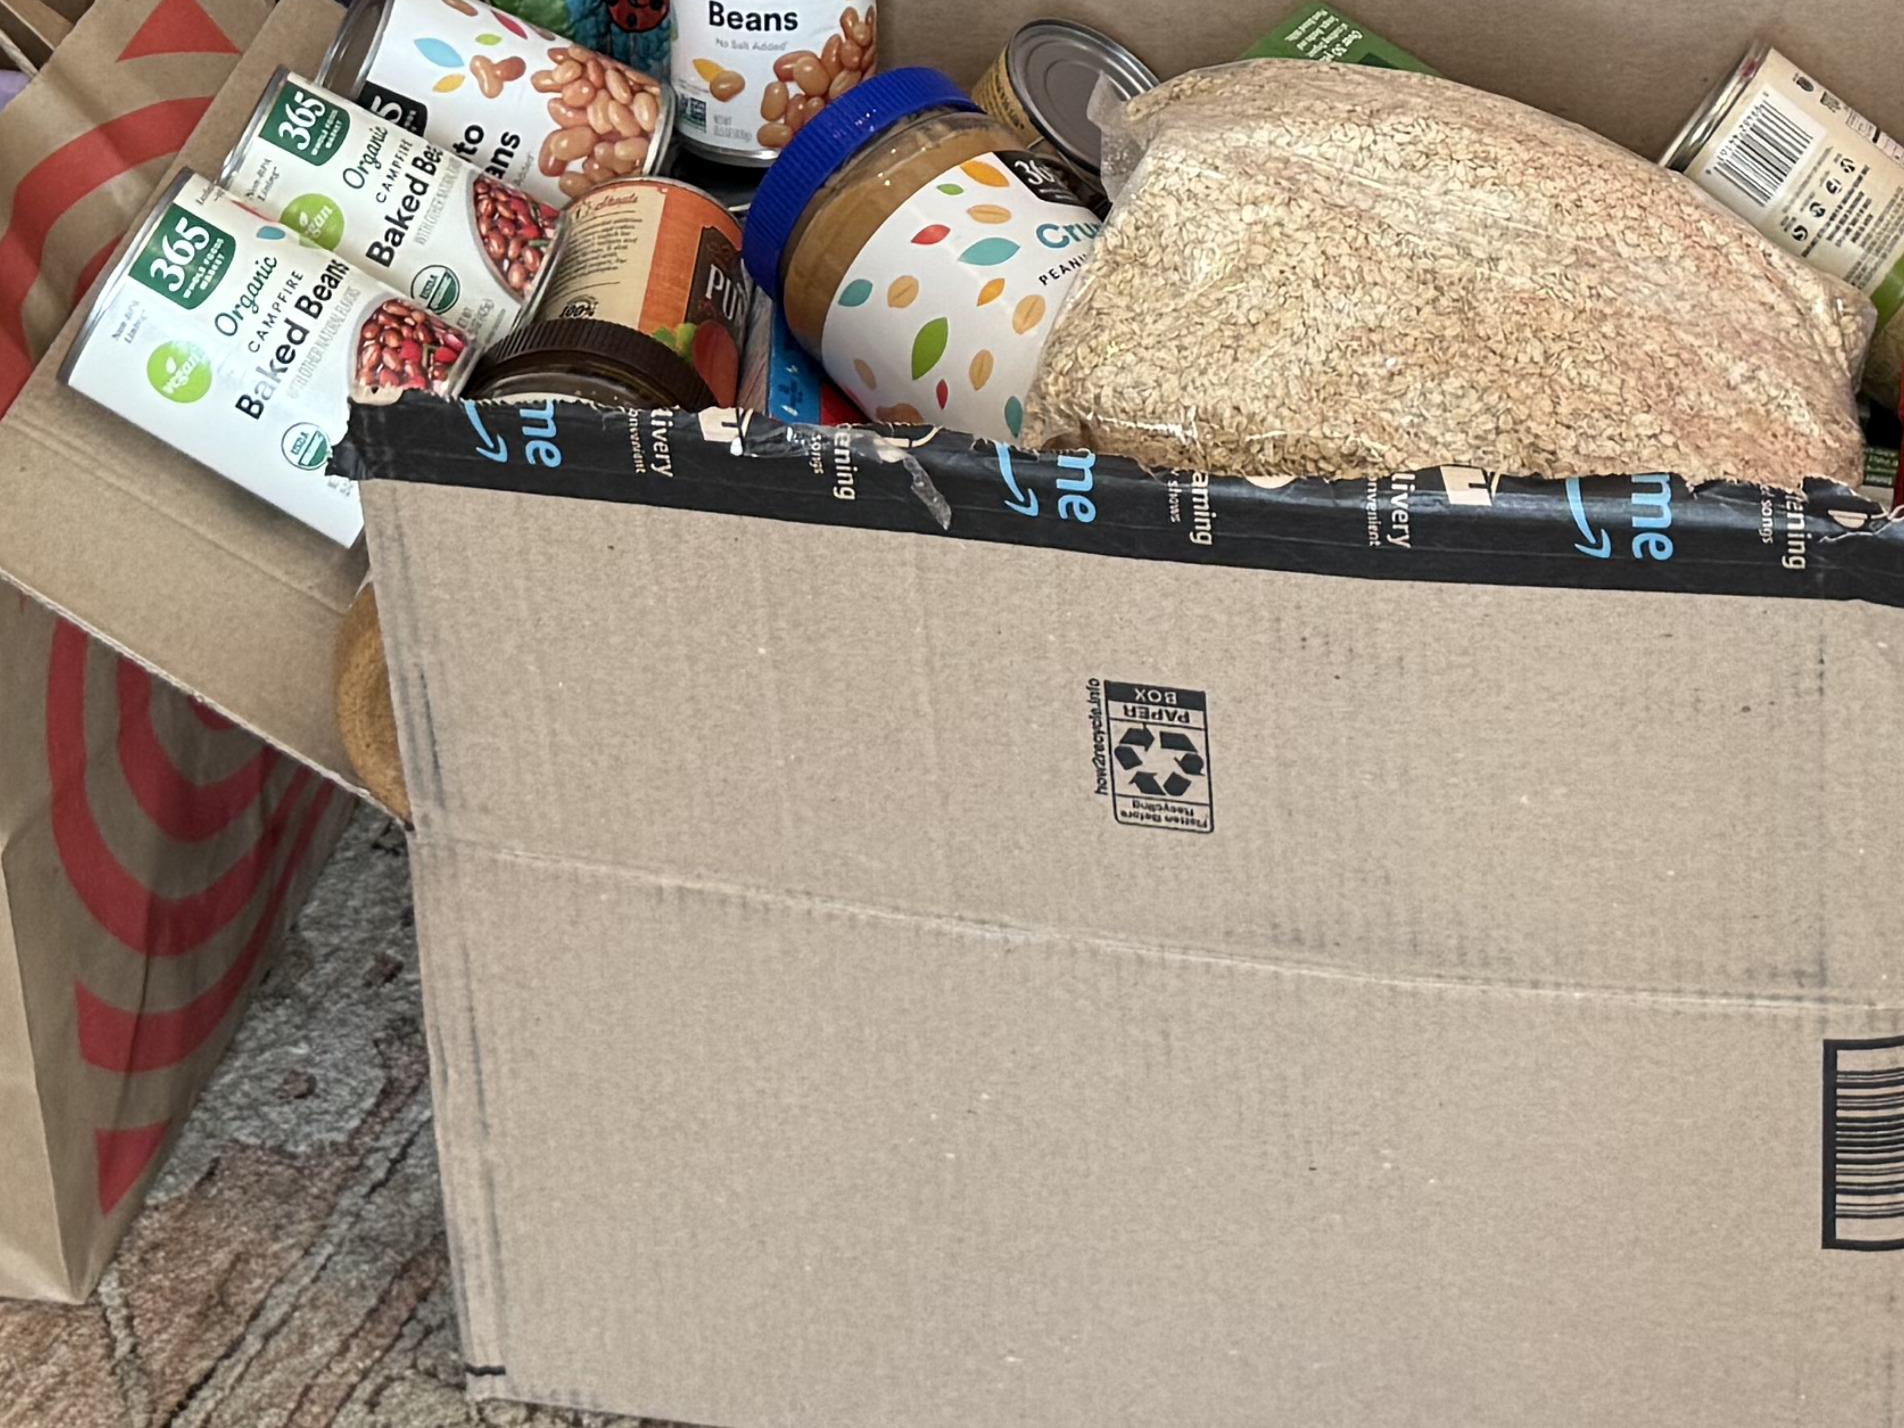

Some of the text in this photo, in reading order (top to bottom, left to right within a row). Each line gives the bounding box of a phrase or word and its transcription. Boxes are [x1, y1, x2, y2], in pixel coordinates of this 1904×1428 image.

[708, 0, 798, 32] Beans
[278, 91, 326, 151] 365
[342, 125, 388, 189] Organic
[150, 216, 210, 292] 365
[366, 175, 429, 267] Baked
[214, 255, 277, 337] Organic
[247, 270, 304, 353] CAMPFIRE
[235, 258, 349, 420] Baked Beans
[1123, 705, 1190, 723] PAPER
[1134, 688, 1177, 704] BOX
[1086, 677, 1108, 795] how2recycle.info
